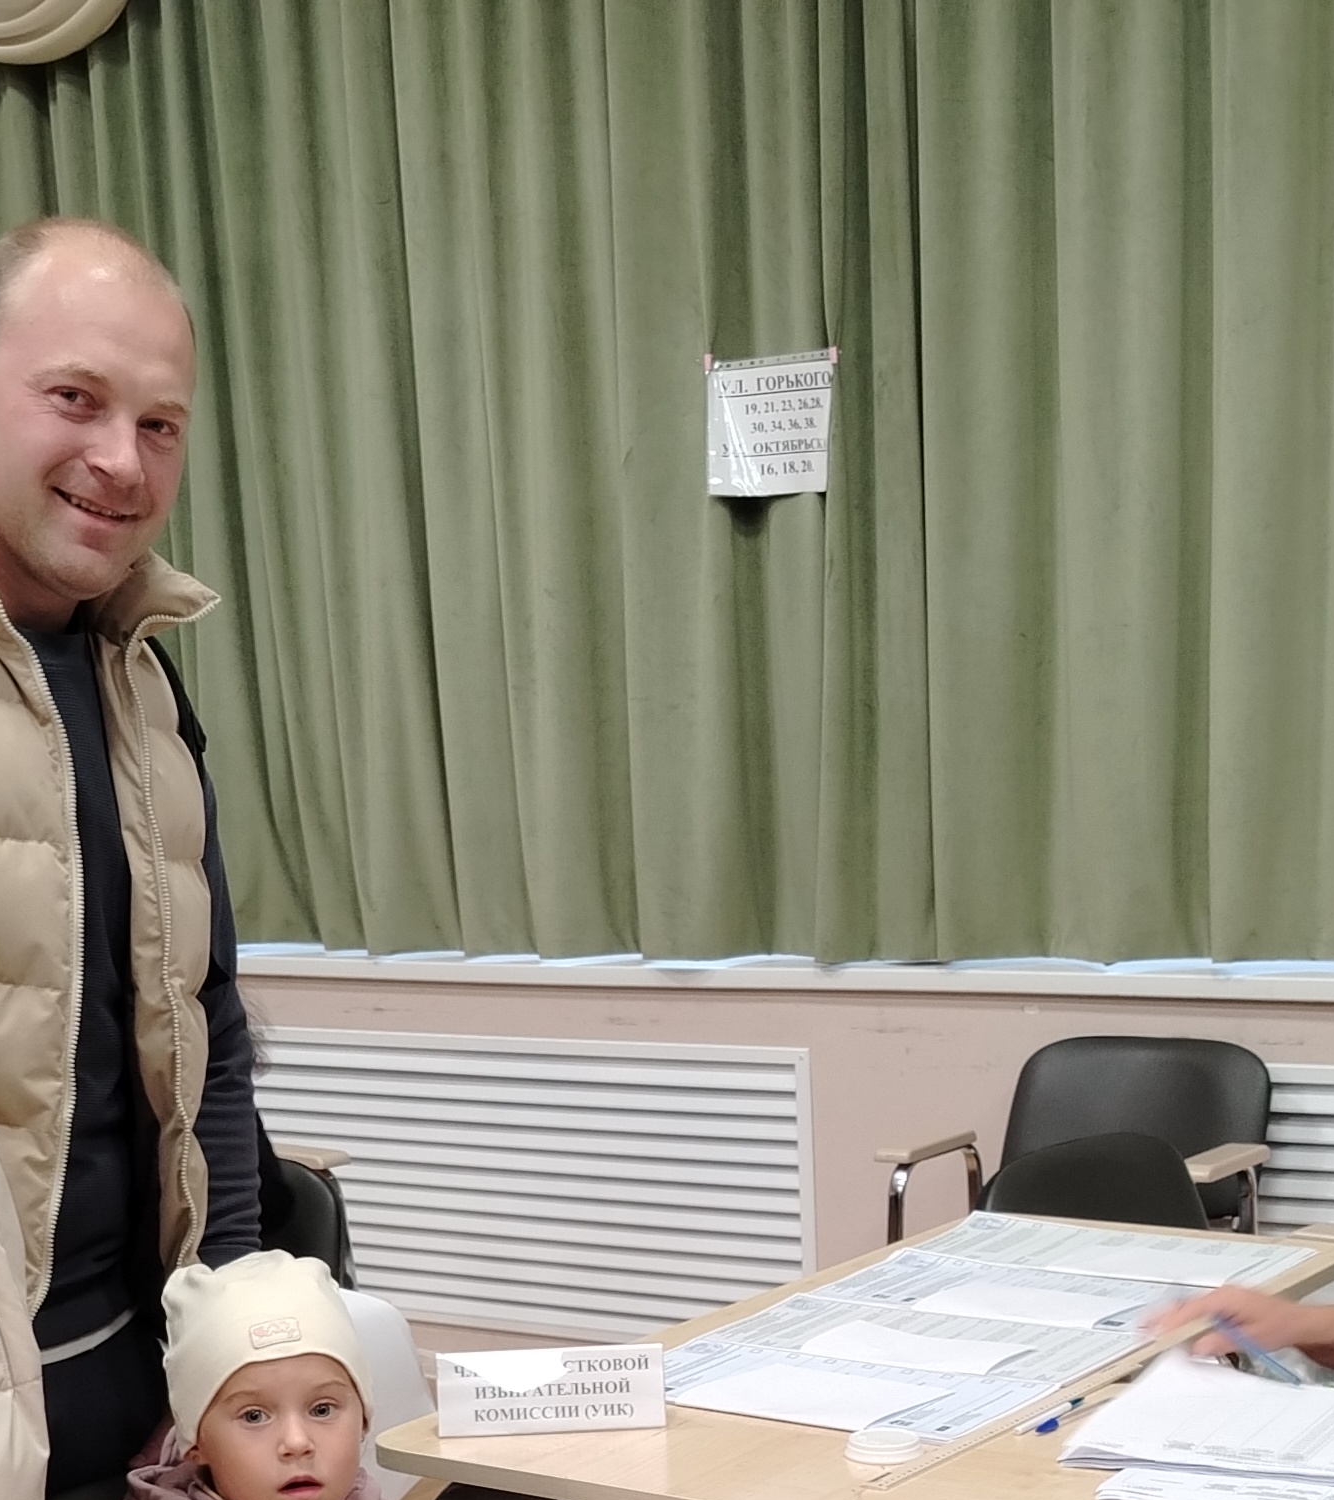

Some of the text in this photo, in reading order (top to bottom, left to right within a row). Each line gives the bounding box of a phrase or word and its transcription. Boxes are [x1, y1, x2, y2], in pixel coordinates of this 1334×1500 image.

[757, 371, 831, 391] ГОРЬКОГО
[563, 1354, 649, 1373] СТКОВОЙ
[474, 1403, 634, 1422] КОМИССИИ (УИК)
